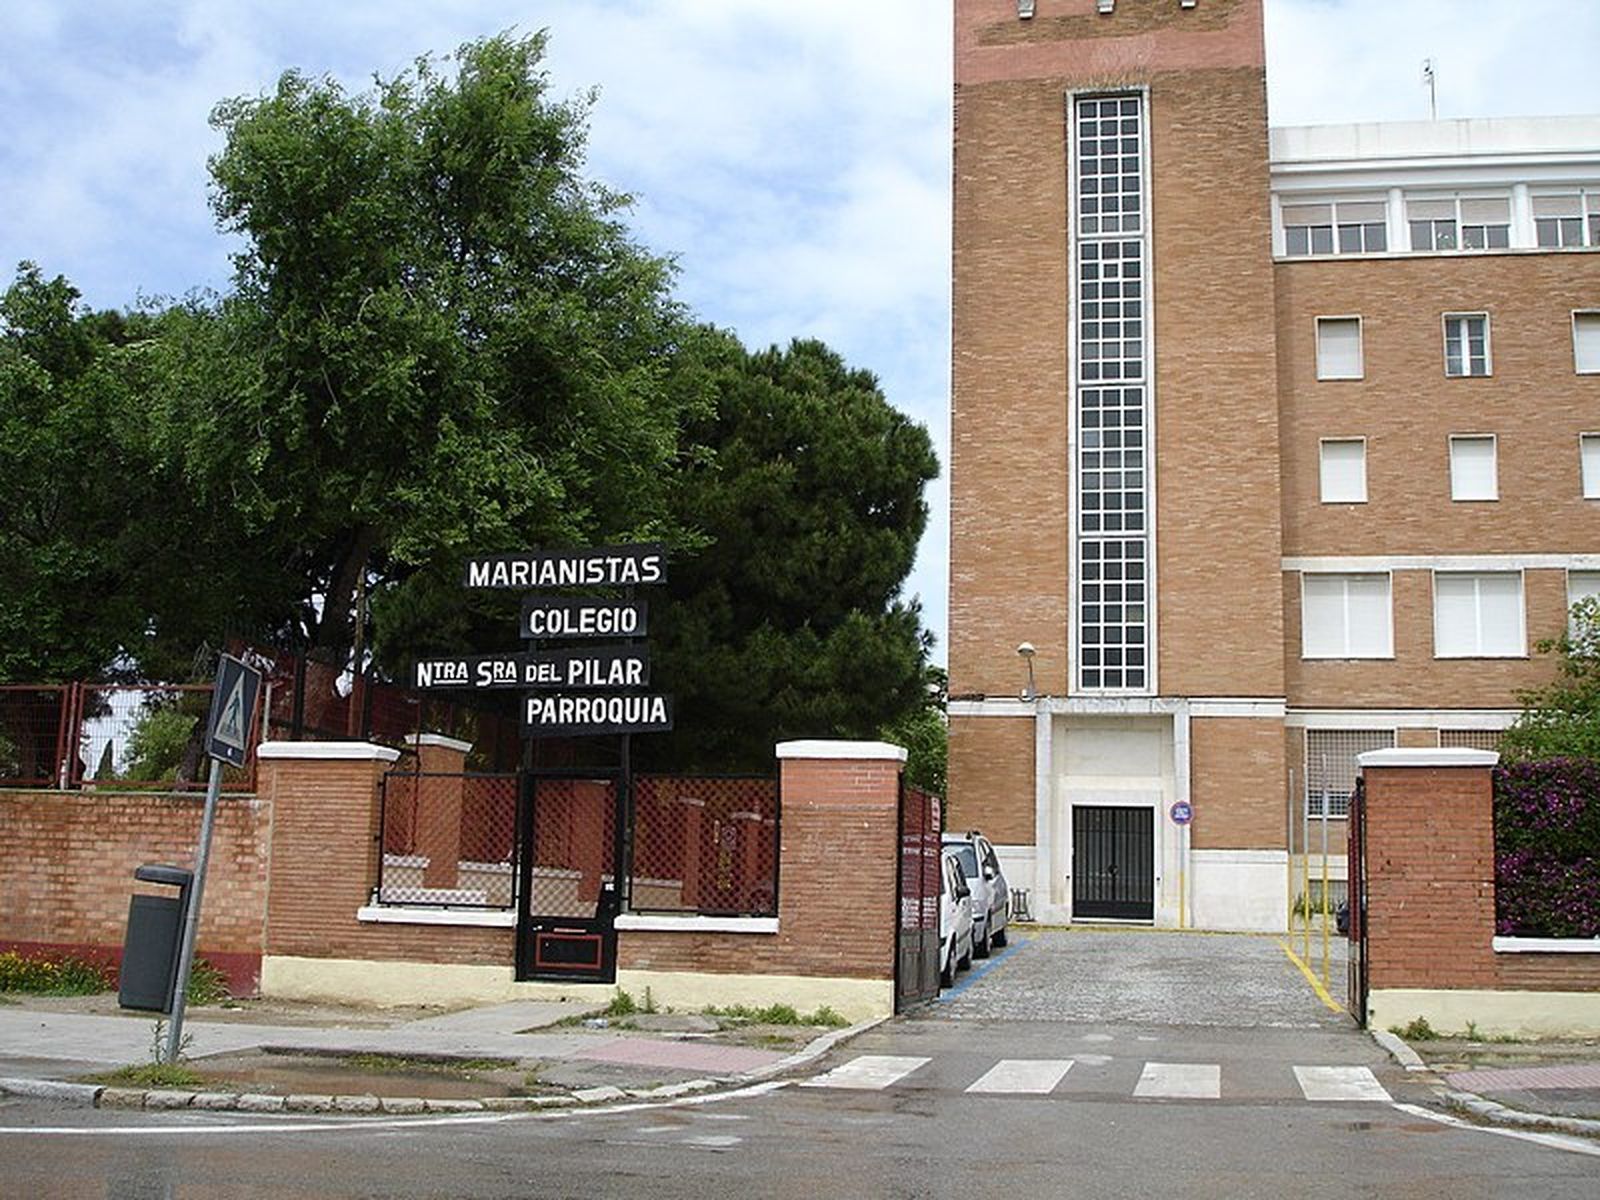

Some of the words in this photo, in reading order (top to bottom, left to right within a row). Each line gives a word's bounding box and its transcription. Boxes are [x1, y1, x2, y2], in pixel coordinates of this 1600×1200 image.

[469, 556, 661, 587] MARIANISTAS
[530, 607, 637, 634] COLEGIO
[525, 664, 562, 683] DEL
[568, 659, 643, 685] PILAR
[527, 697, 667, 724] PARROQUIA
